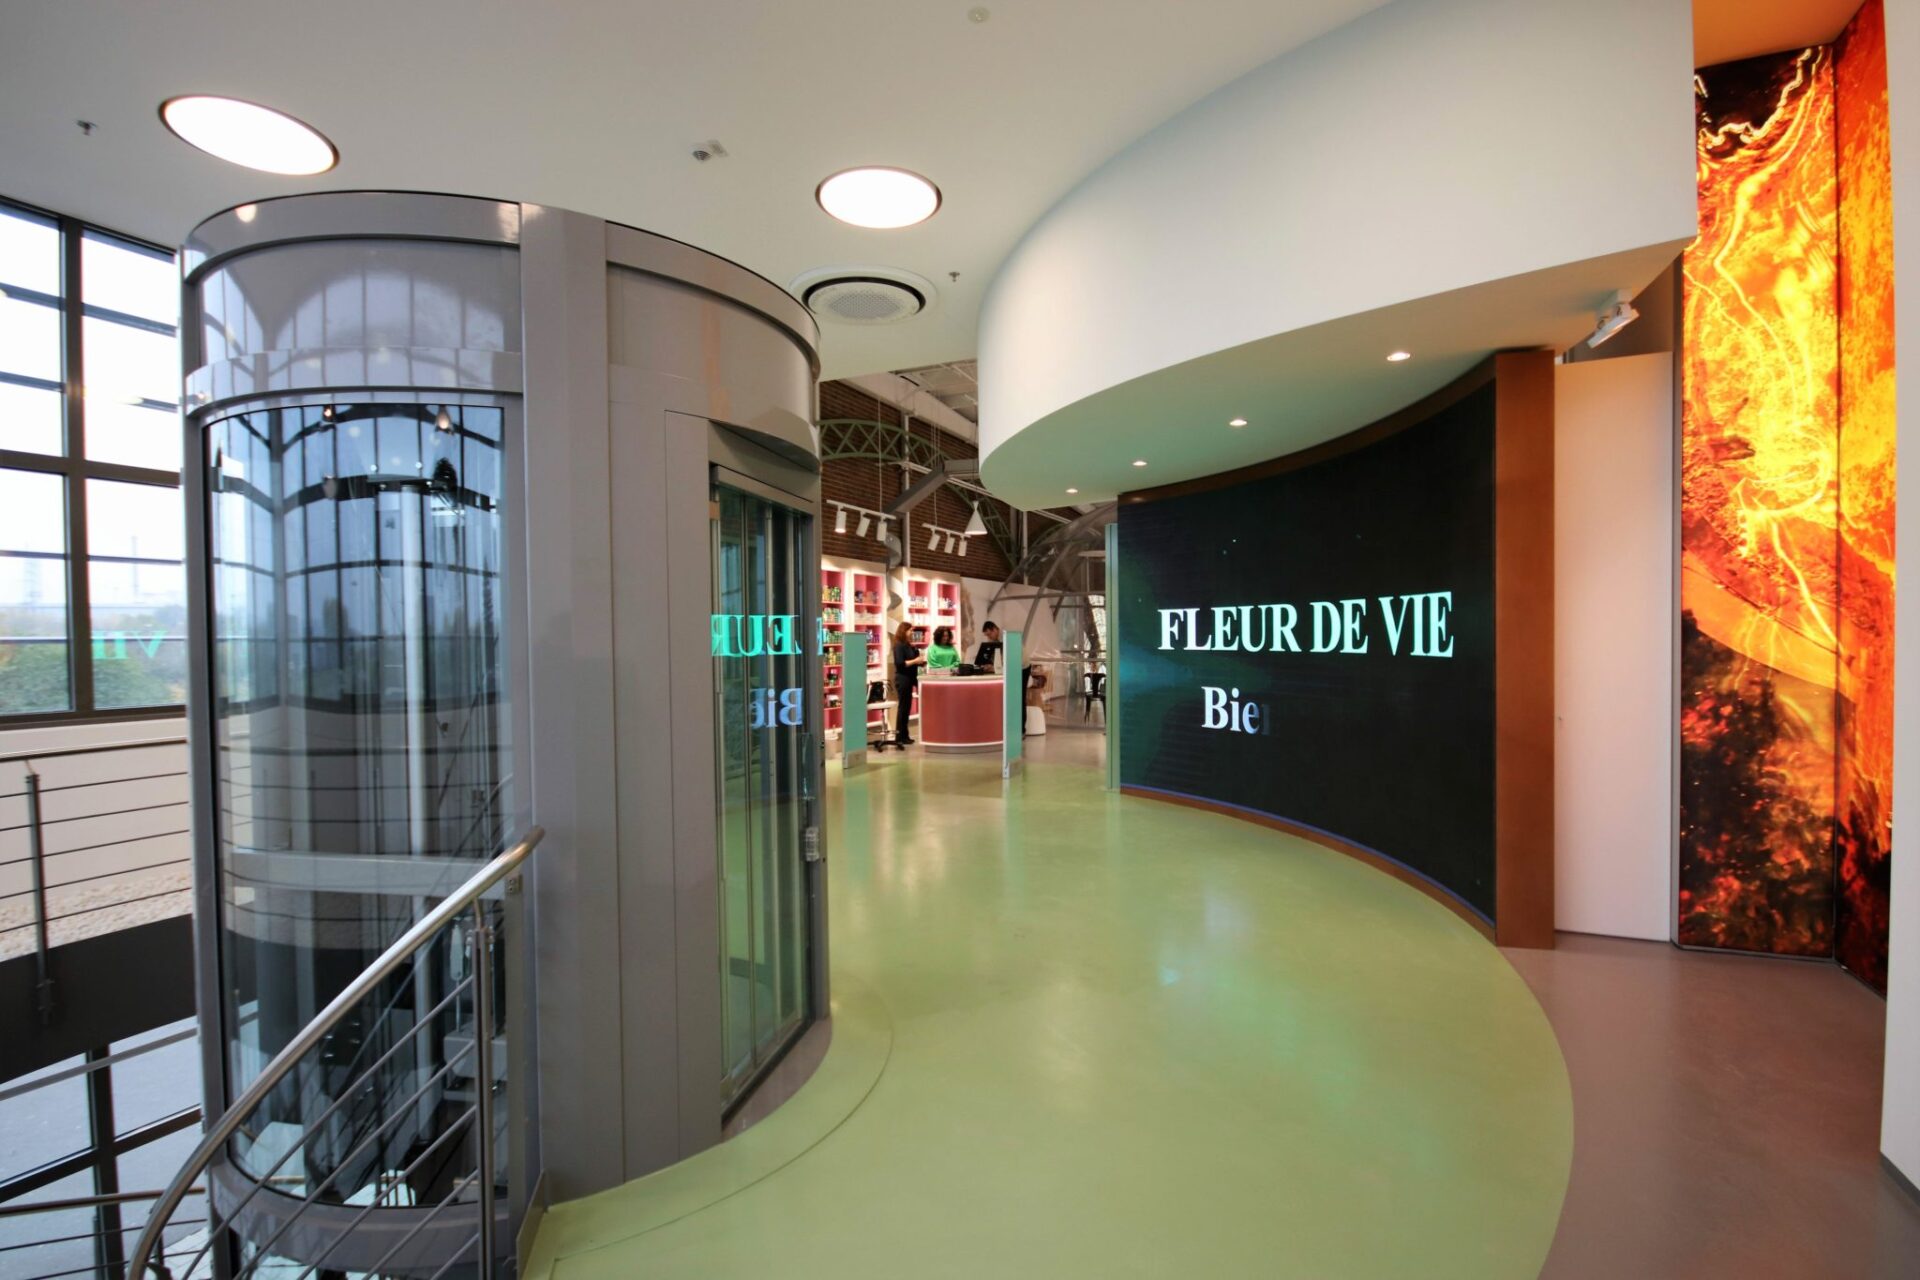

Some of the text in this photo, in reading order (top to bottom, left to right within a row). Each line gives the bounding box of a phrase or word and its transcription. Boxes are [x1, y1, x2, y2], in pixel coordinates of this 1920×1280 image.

[1157, 591, 1454, 658] FLEUR DE VIE
[1201, 686, 1270, 736] Bie
